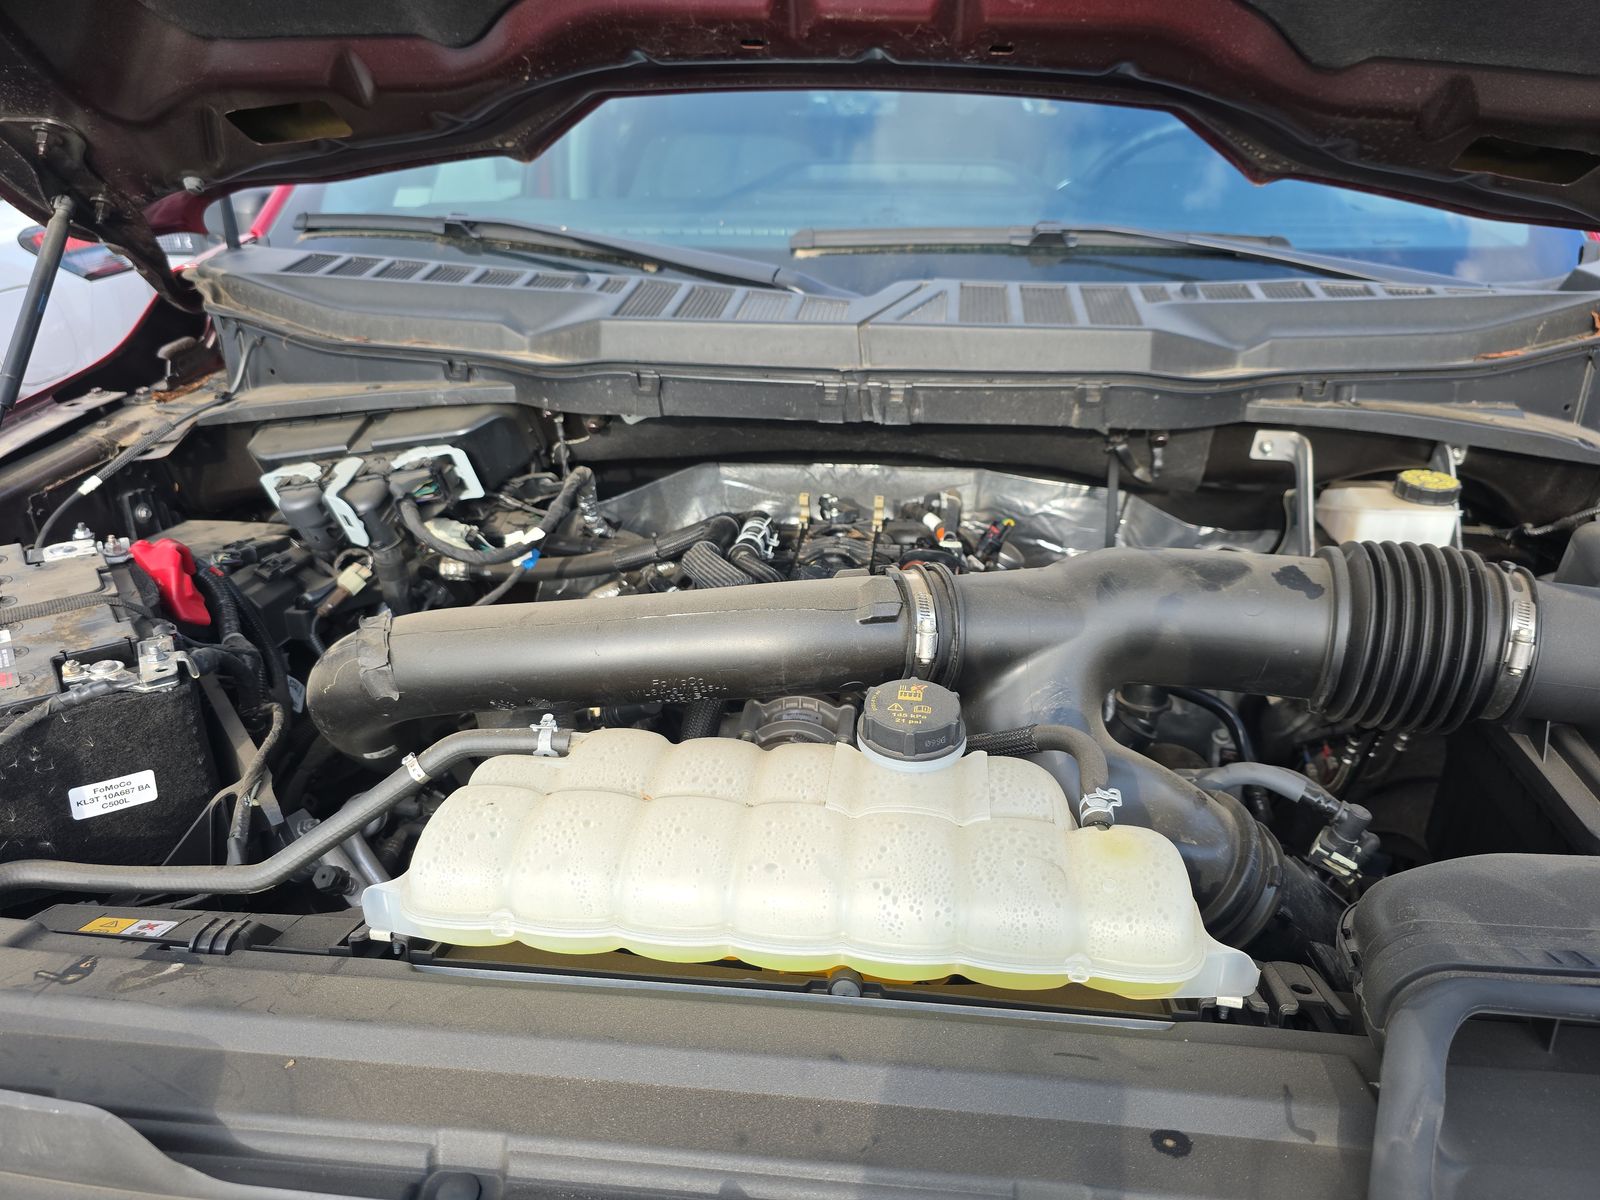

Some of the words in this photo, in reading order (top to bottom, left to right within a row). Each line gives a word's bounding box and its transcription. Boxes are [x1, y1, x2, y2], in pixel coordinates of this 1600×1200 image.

[93, 781, 132, 795] FoMoCo
[76, 796, 101, 808] KL3T
[103, 787, 135, 801] 10A687
[137, 783, 151, 792] BA
[101, 797, 130, 809] C500L
